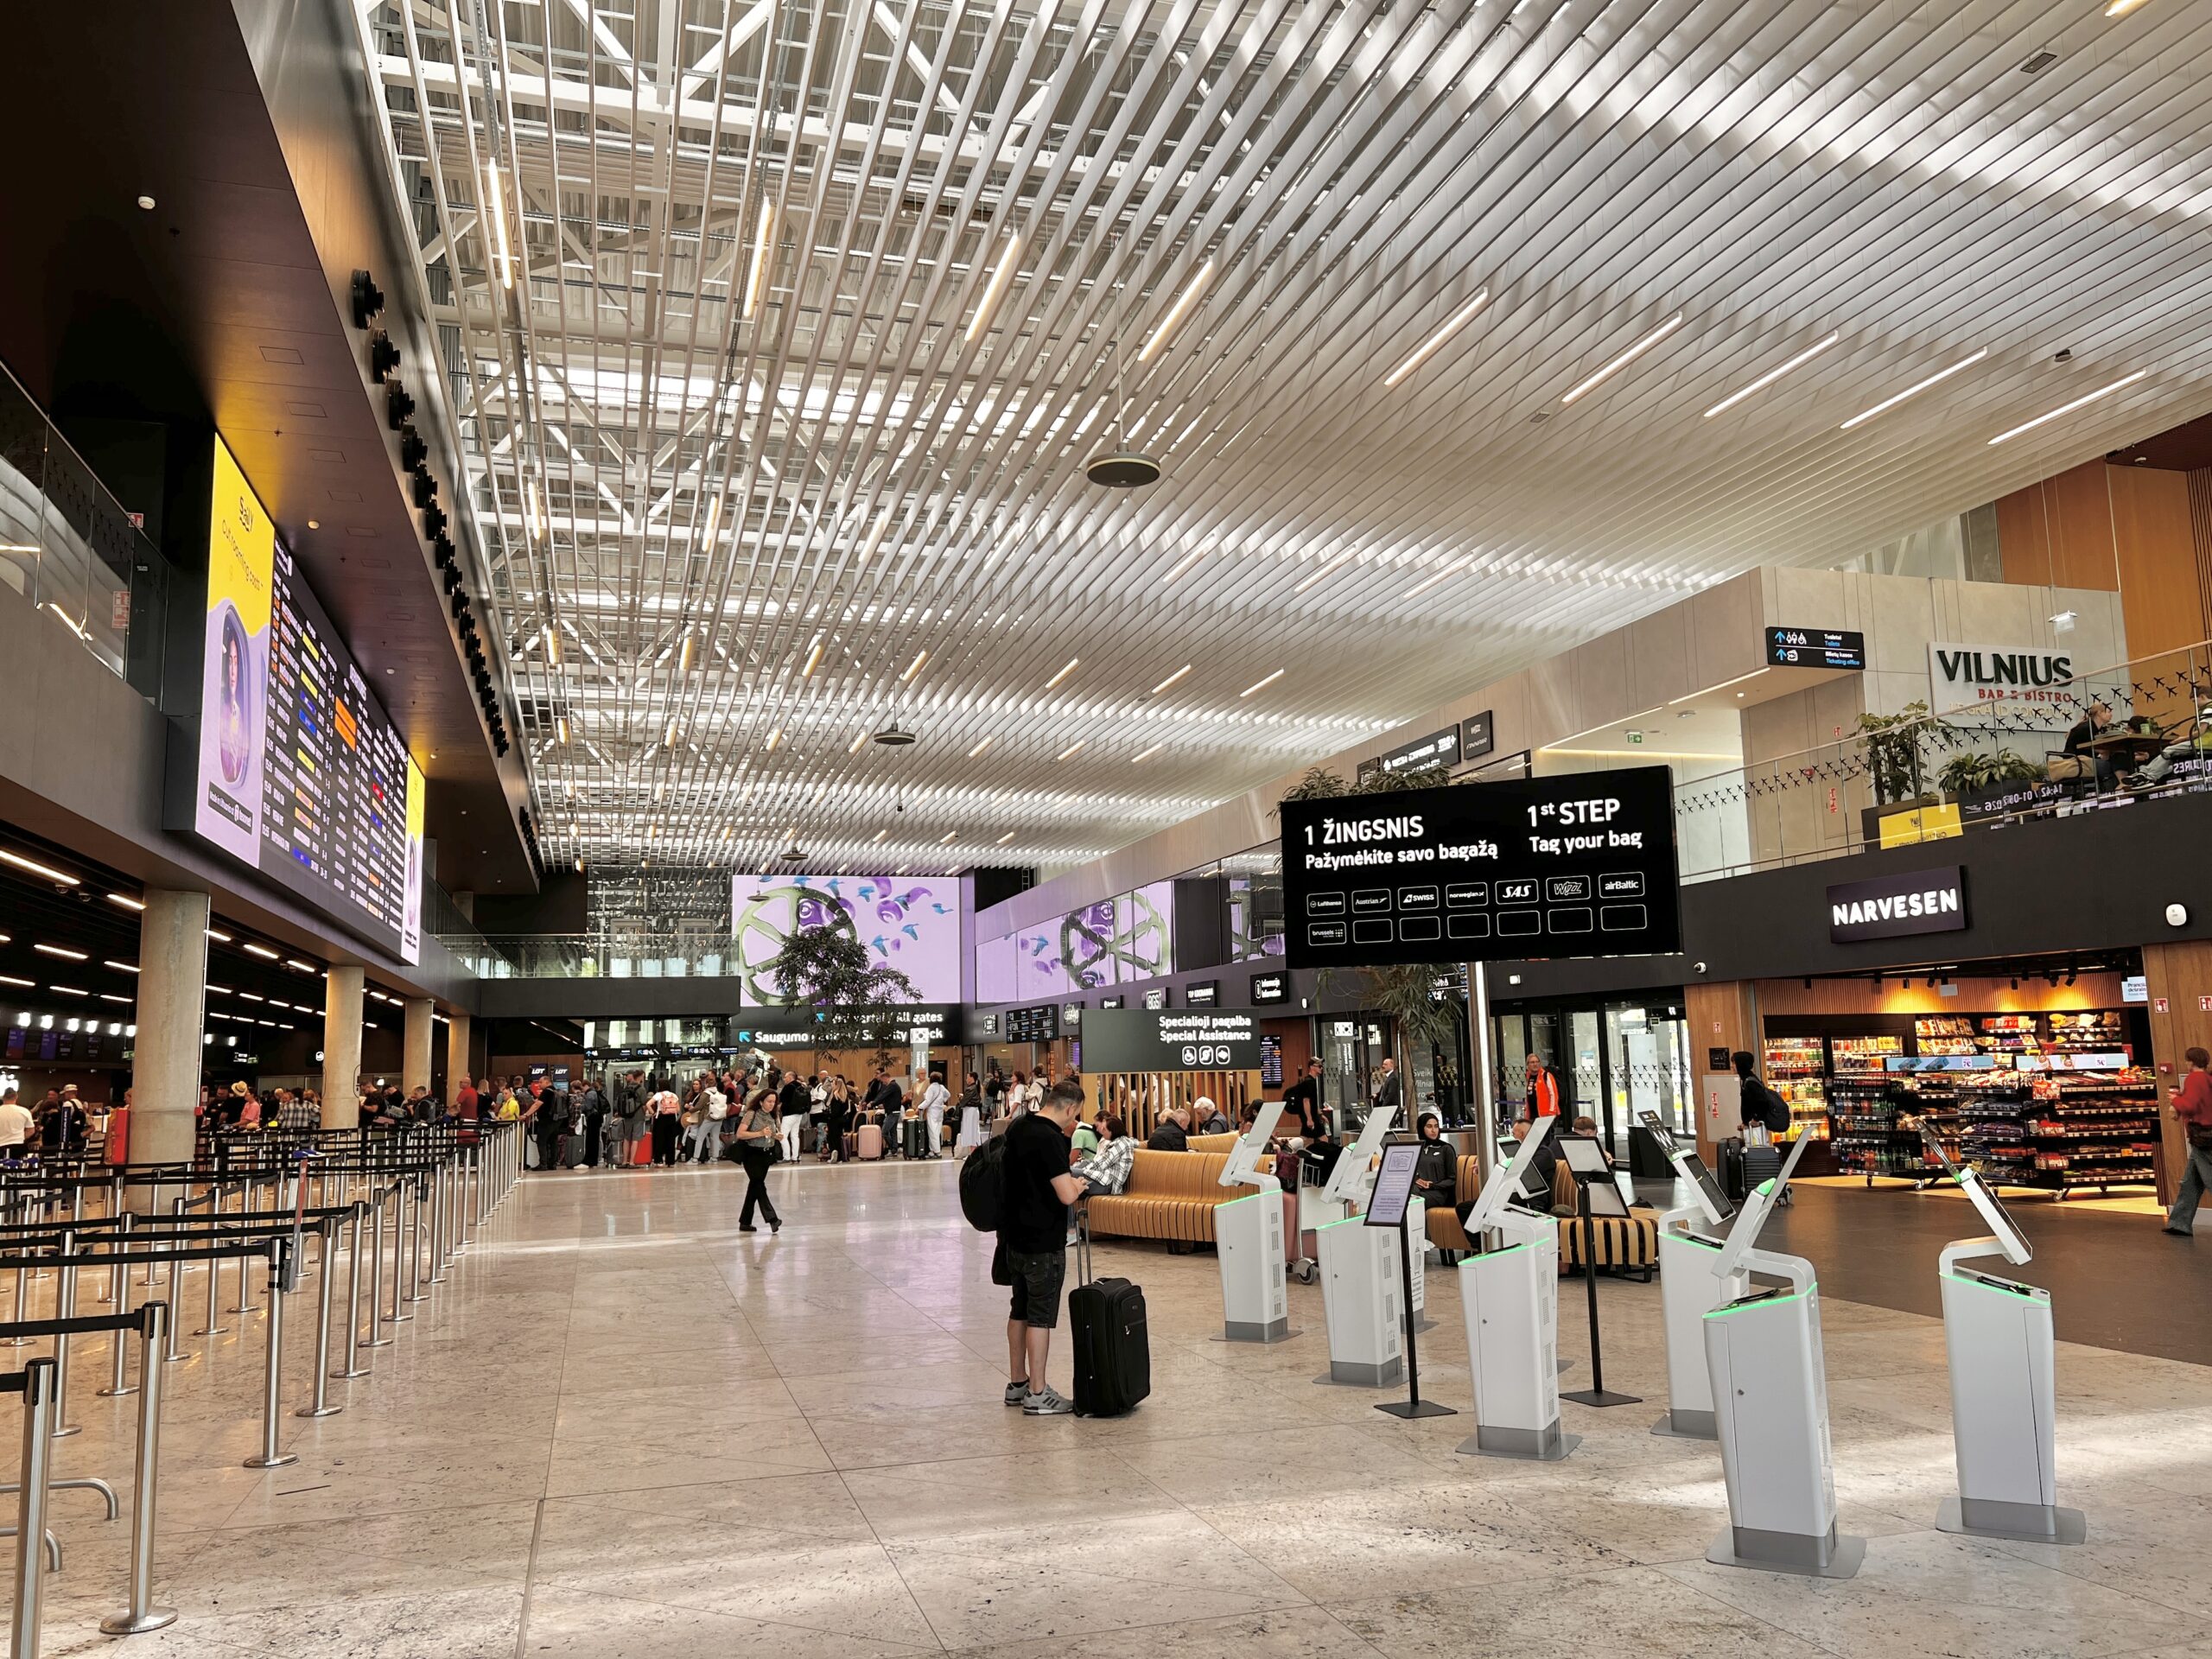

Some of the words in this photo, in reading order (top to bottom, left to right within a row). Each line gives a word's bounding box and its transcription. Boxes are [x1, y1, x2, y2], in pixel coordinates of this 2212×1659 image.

[1936, 650, 2073, 687] VILNIUS
[1978, 688, 2004, 699] BAR
[2024, 690, 2072, 702] BISTRO
[1527, 802, 1555, 827] 1st
[1559, 798, 1621, 825] STEP
[1305, 825, 1313, 845] 1
[1323, 816, 1424, 844] ŽINGSNIS
[1529, 836, 1560, 855] Tag
[1564, 835, 1605, 854] your
[1609, 830, 1643, 849] bag
[1306, 849, 1394, 871] Pažymėkite
[1397, 848, 1434, 862] savo
[1439, 839, 1498, 861] bagažą
[1503, 886, 1531, 898] SAS
[1605, 880, 1639, 890] airBaltic
[1832, 887, 1959, 926] NARVESEN
[913, 1012, 944, 1025] gates
[1159, 1015, 1210, 1030] Specialioji
[1211, 1015, 1251, 1030] pagalba
[754, 1031, 808, 1046] Saugumo
[1160, 1030, 1197, 1043] Special
[1198, 1030, 1251, 1041] Assistance
